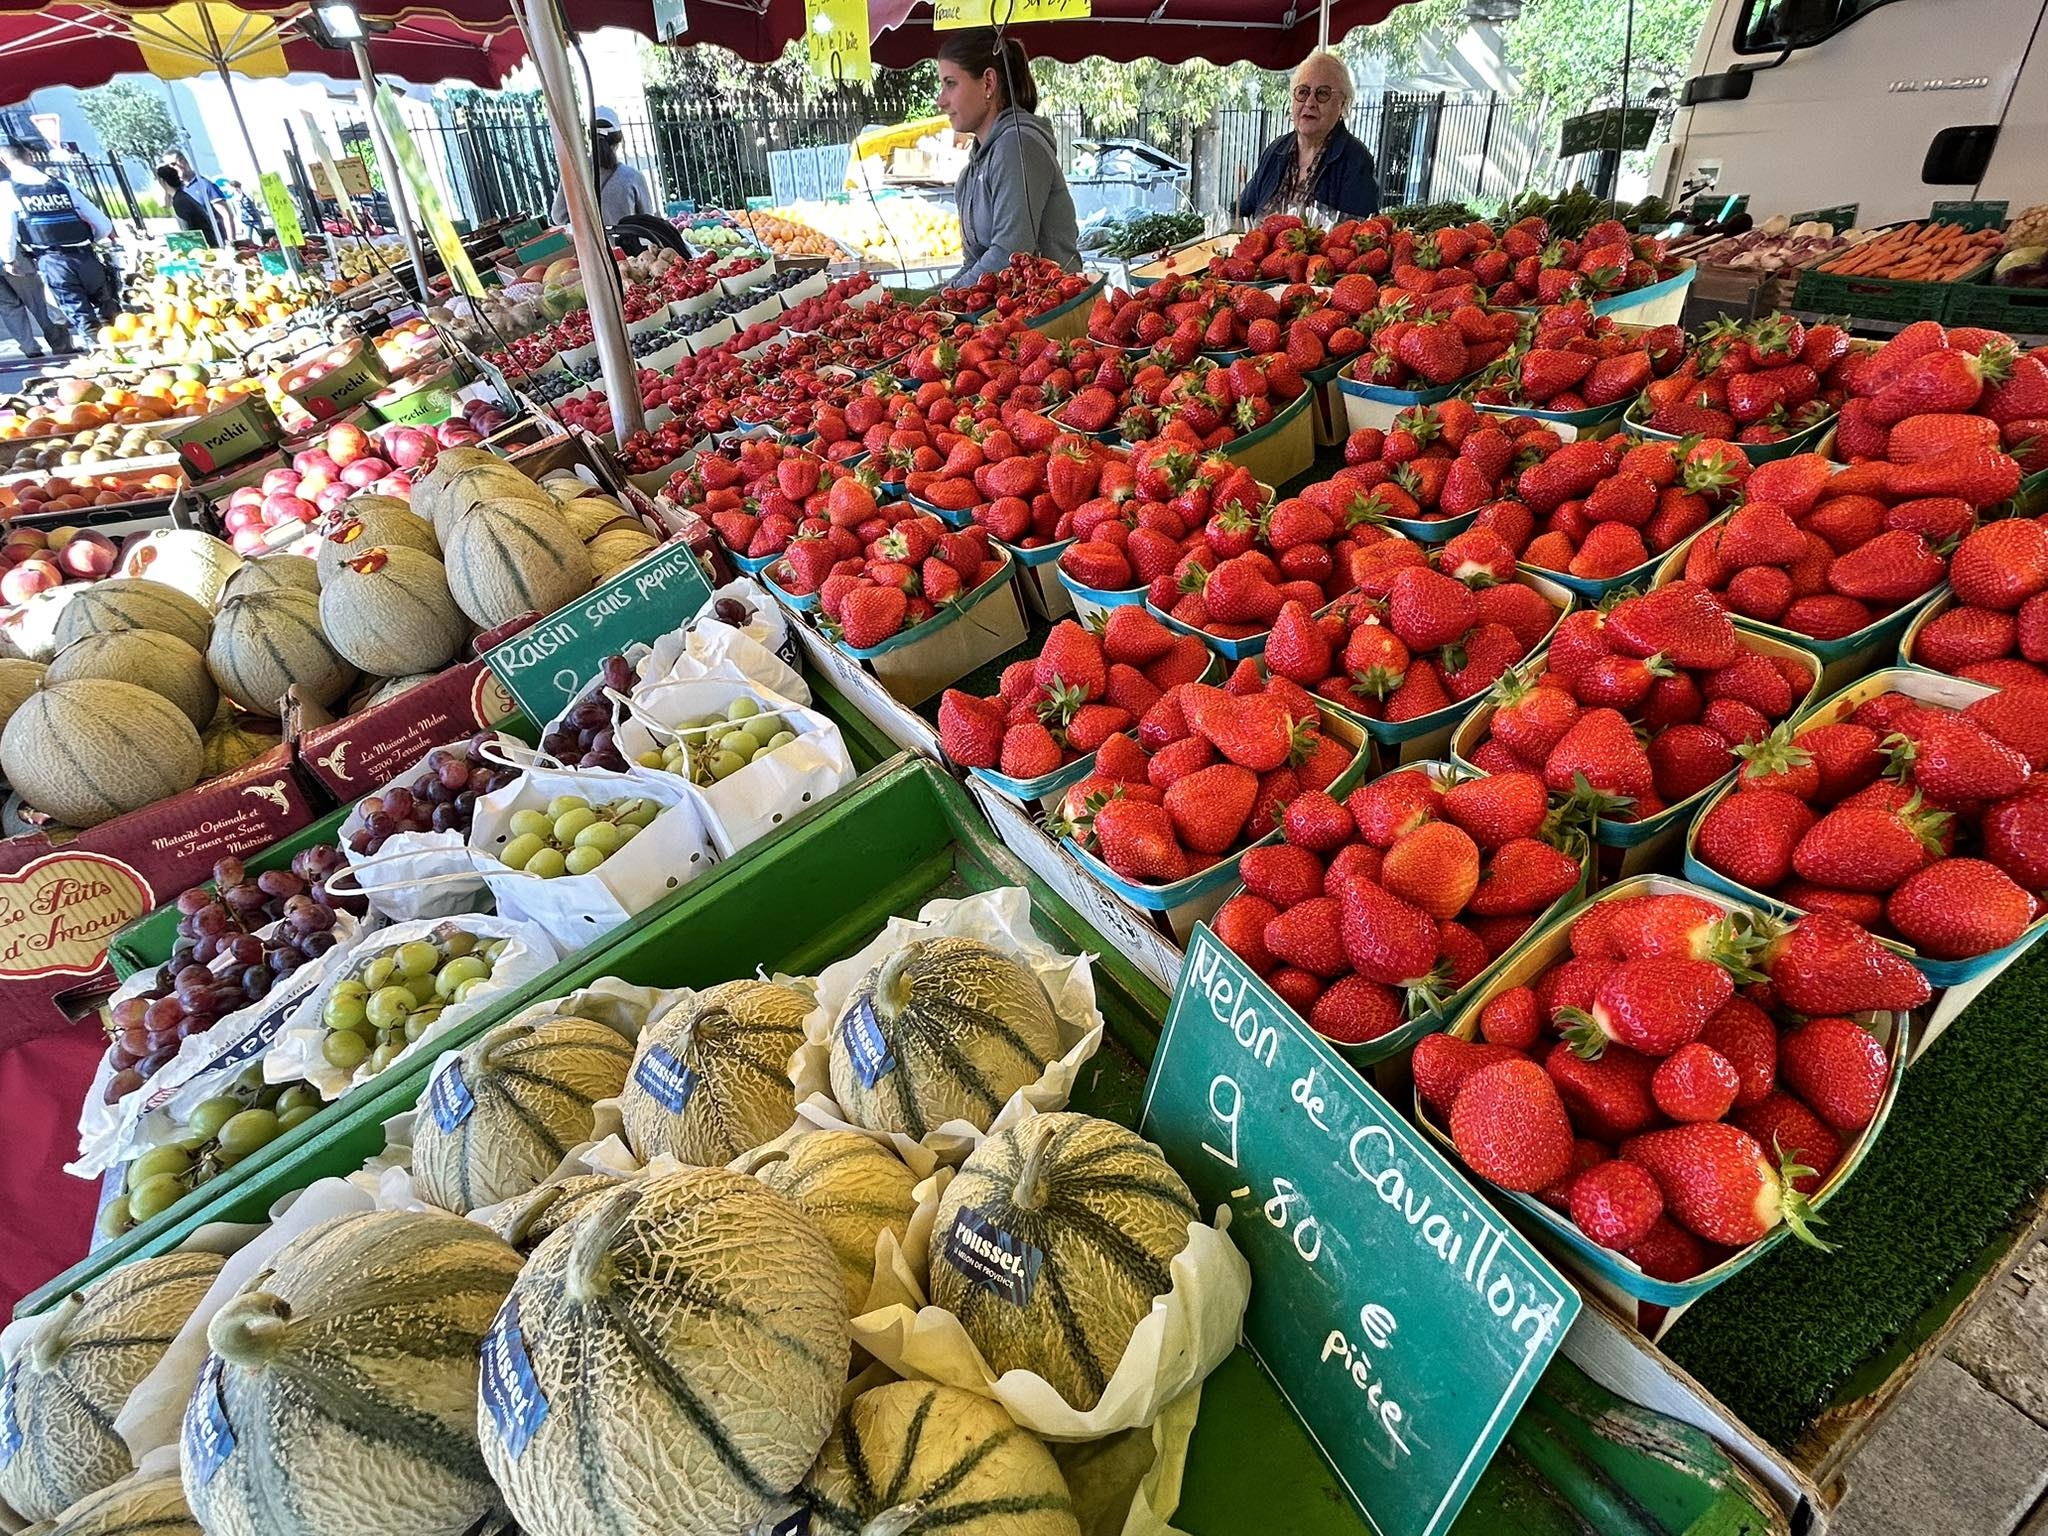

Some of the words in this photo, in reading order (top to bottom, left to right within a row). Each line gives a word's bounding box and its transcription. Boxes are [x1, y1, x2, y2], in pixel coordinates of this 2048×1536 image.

[22, 193, 71, 211] POLICE
[330, 370, 371, 401] rockit
[398, 403, 430, 423] rockit
[204, 421, 250, 451] rockit
[496, 621, 579, 677] Raisin
[585, 587, 632, 627] sans
[635, 553, 690, 601] pepins
[360, 751, 375, 765] La
[373, 735, 407, 758] Maison
[408, 726, 419, 739] du
[418, 713, 447, 732] Melon
[393, 737, 432, 764] Terraube
[152, 829, 200, 850] Maturité
[200, 810, 247, 834] Optimale
[249, 808, 258, 818] et
[176, 847, 185, 857] à
[184, 836, 223, 855] Teneur
[224, 833, 236, 842] en
[237, 821, 266, 836] Sucre
[29, 877, 112, 915] Puits
[1190, 950, 1279, 1068] Melon
[1290, 1066, 1329, 1132] de
[1349, 1125, 1551, 1350] Cavaillon
[974, 1258, 983, 1270] DE
[982, 1265, 1015, 1289] PROVENCE
[1360, 1303, 1397, 1349] €
[1320, 1329, 1411, 1455] pièce
